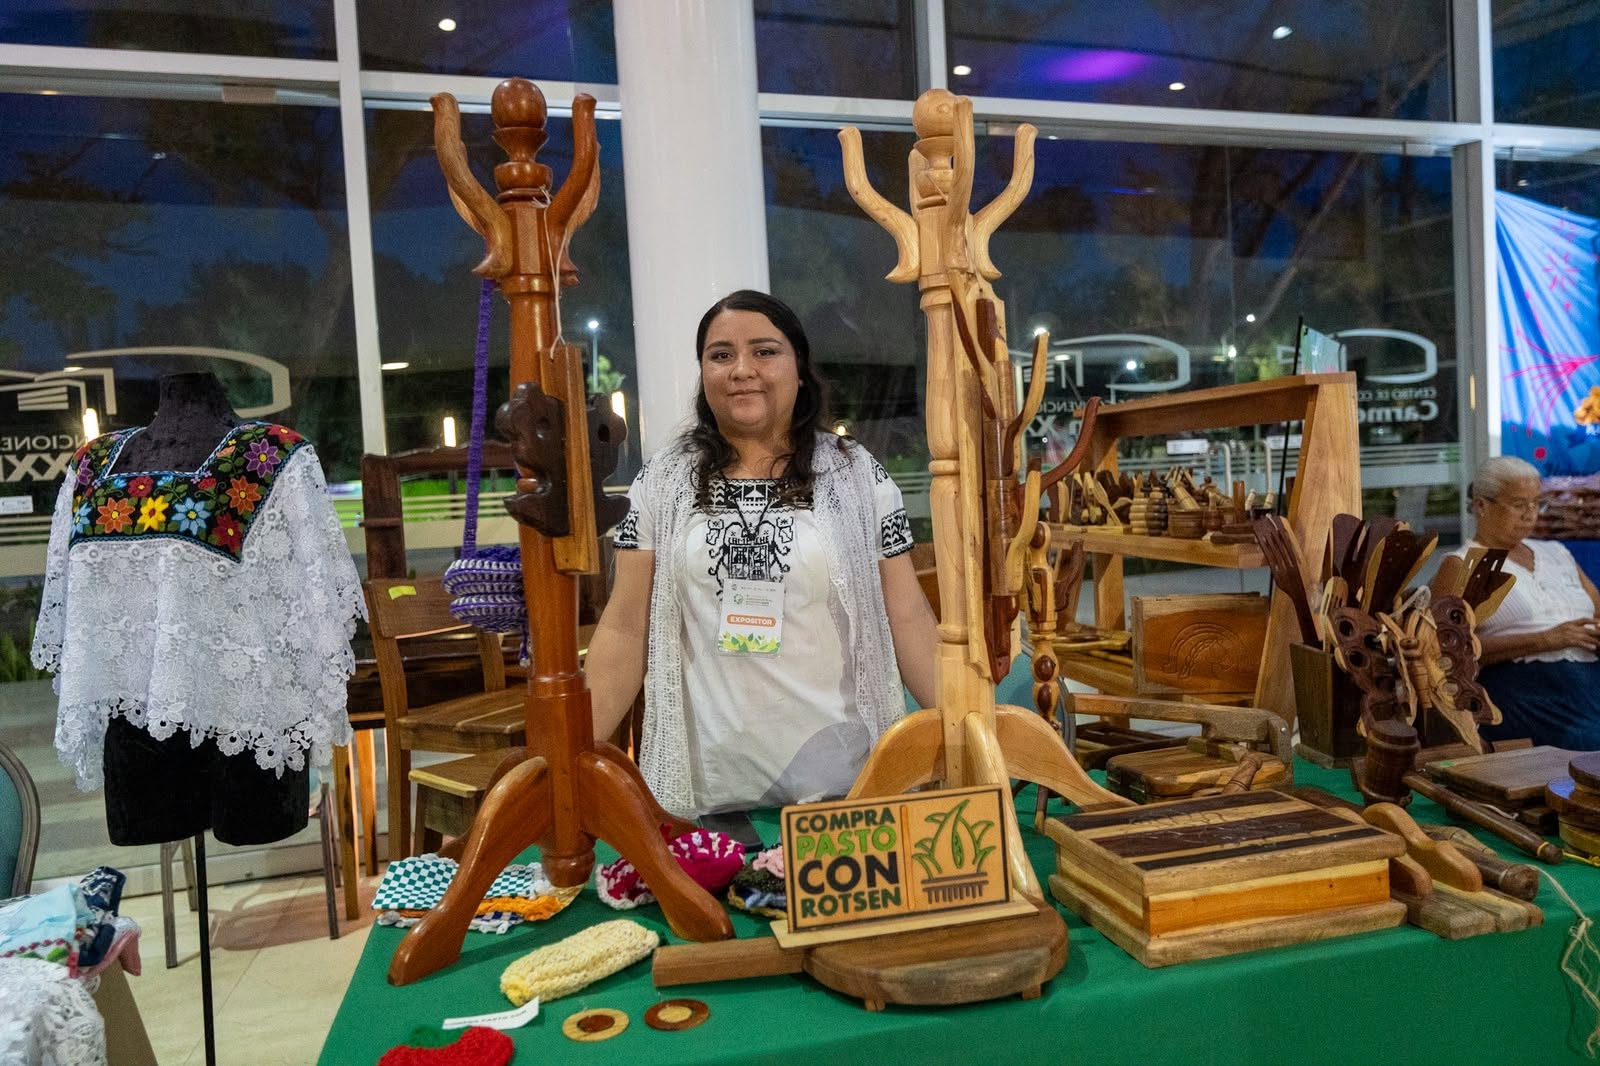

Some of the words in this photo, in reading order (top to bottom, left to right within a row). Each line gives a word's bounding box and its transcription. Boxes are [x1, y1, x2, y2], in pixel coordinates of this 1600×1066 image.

[728, 536, 769, 545] CAMPCHE
[730, 616, 773, 625] EXPOSITOR
[795, 807, 896, 833] COMPRA
[797, 826, 897, 861] PASTO
[798, 851, 900, 895] CON
[801, 886, 902, 919] ROTSEN
